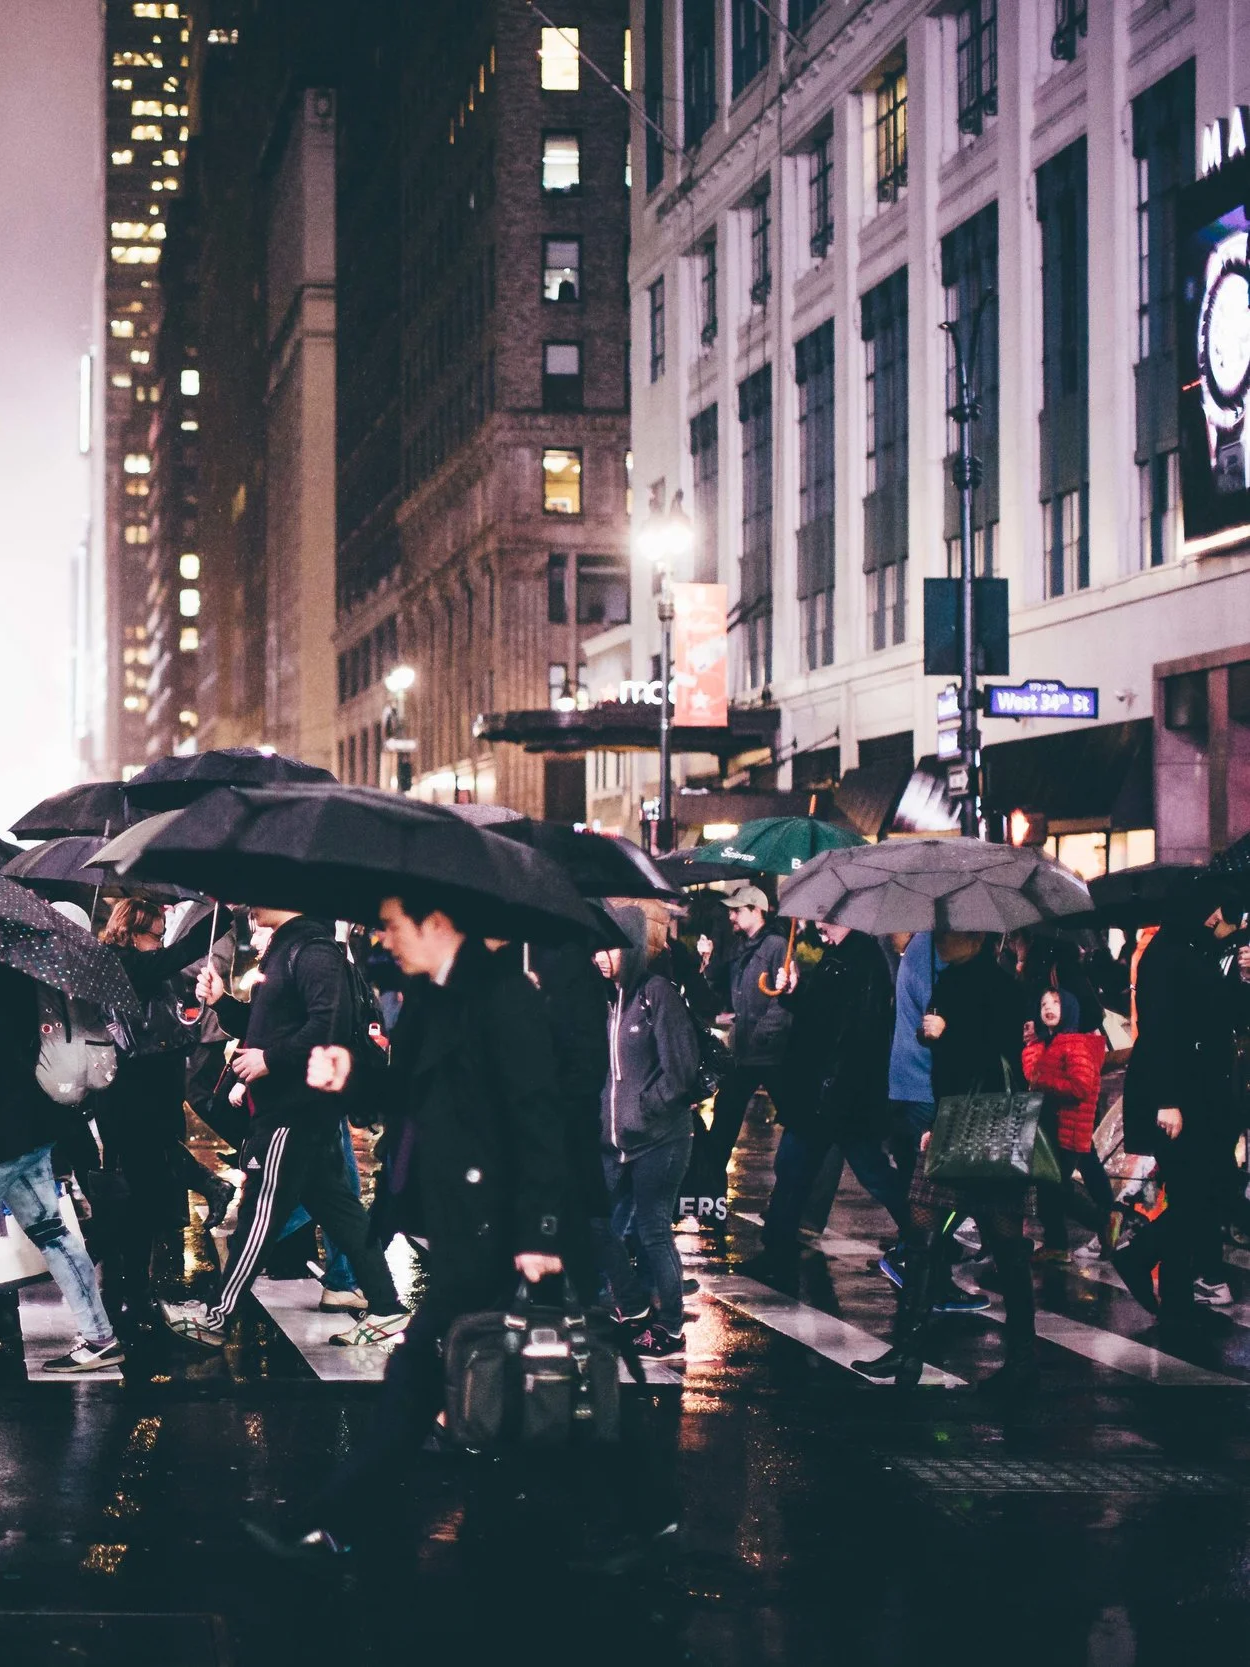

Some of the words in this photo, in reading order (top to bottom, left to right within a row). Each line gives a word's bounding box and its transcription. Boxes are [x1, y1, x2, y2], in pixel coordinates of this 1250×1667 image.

[997, 692, 1038, 711] West
[1072, 694, 1091, 713] St
[679, 1196, 727, 1220] ERS
